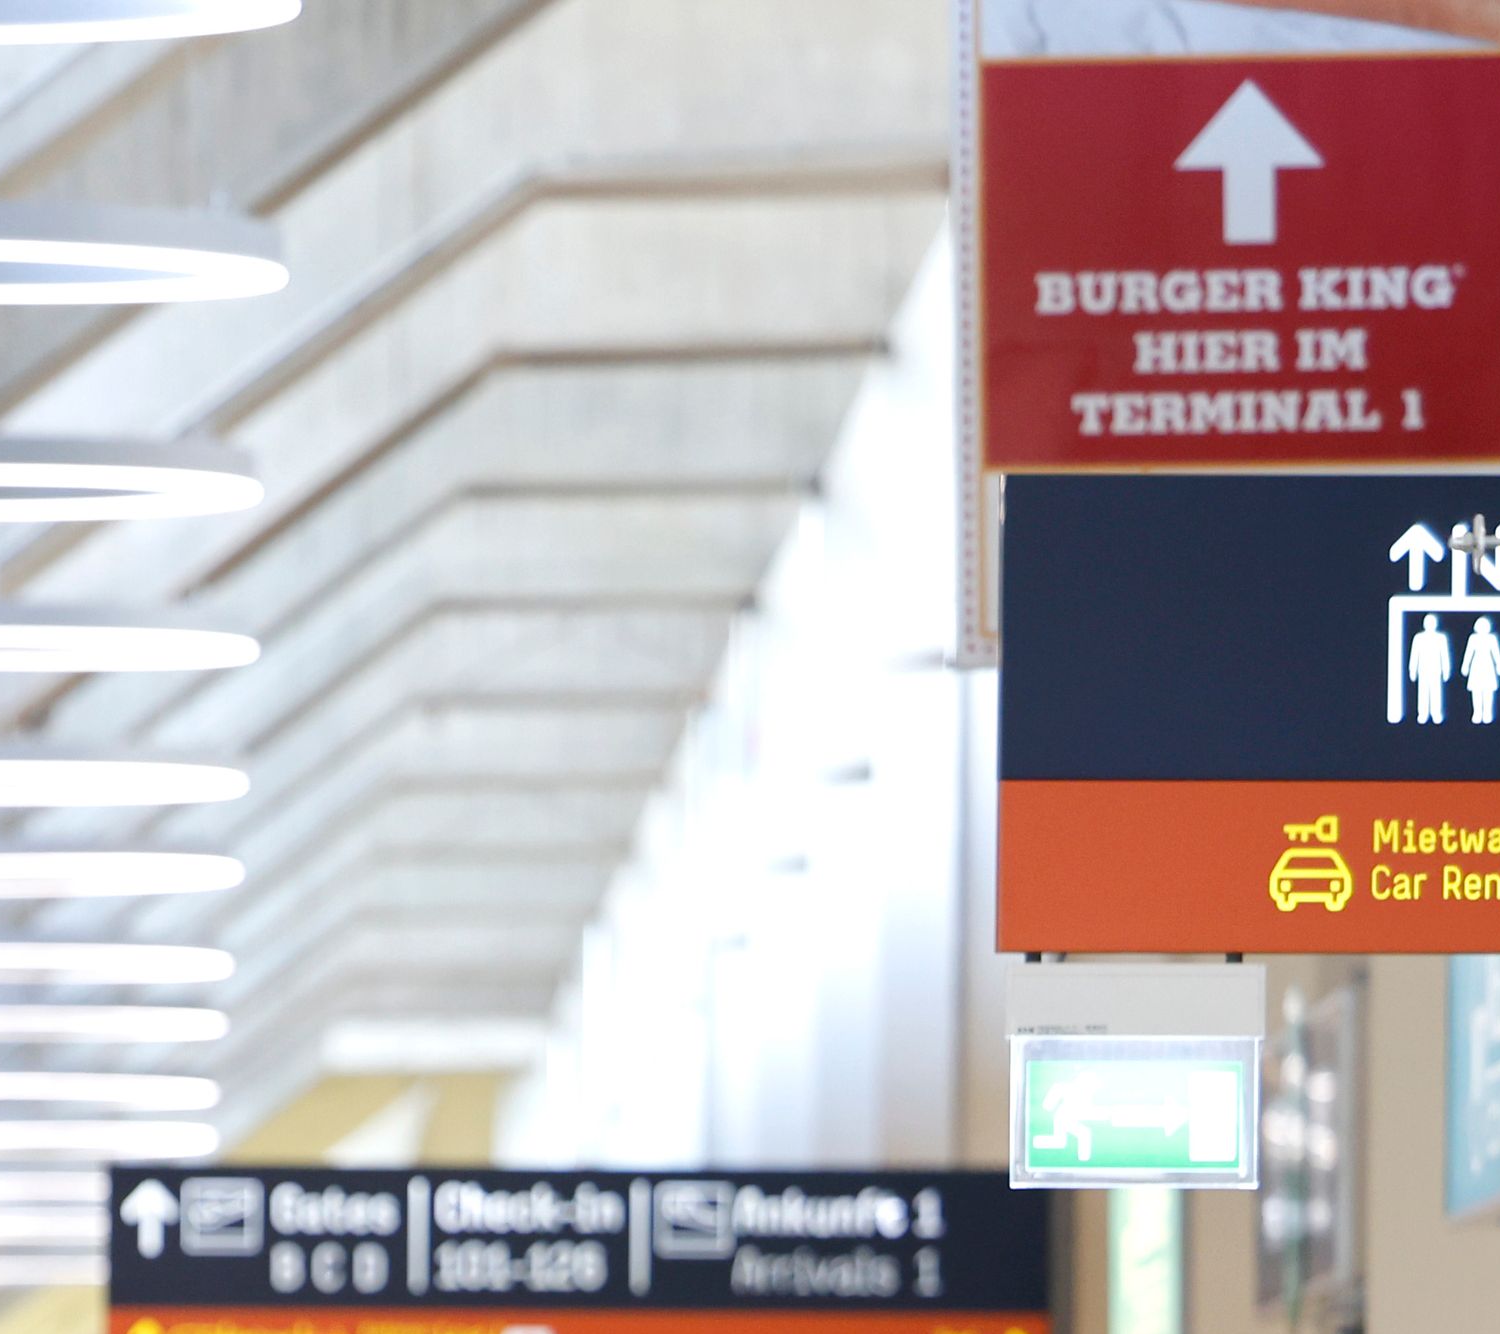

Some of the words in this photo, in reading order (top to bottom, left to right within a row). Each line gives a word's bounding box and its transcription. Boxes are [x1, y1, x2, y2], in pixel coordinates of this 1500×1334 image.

[1034, 269, 1283, 315] BURGER
[1133, 331, 1279, 375] HIER
[1296, 329, 1367, 371] IM
[1071, 390, 1381, 435] TERMINAL
[1401, 389, 1425, 430] 1
[1371, 865, 1427, 899] Car
[433, 1181, 625, 1234] Check-in
[730, 1244, 901, 1297] Arrivals
